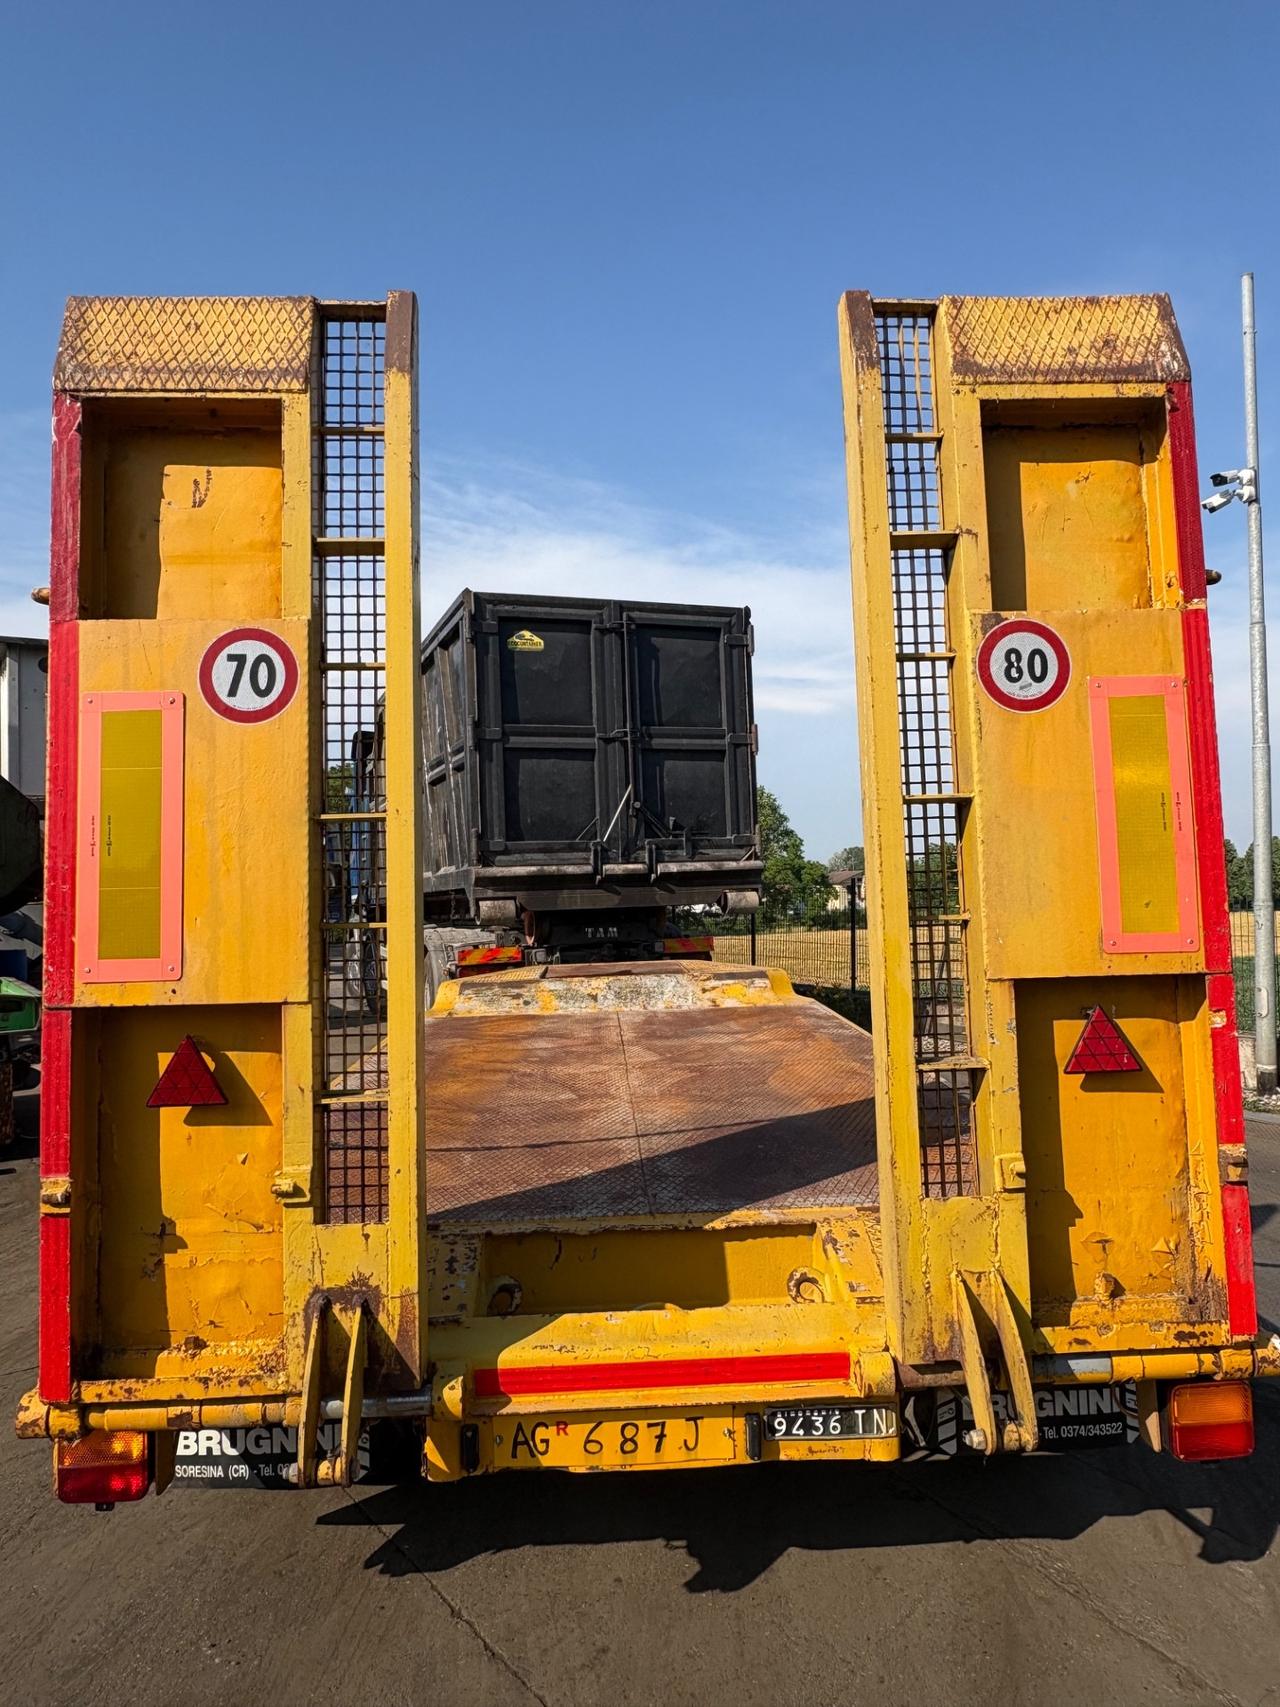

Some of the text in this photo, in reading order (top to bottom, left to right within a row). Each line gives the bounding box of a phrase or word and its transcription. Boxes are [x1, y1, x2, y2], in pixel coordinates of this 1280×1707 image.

[226, 653, 277, 698] 70
[1004, 647, 1048, 684] 80
[774, 1415, 841, 1436] 9436
[1043, 1422, 1123, 1439] Tel. 0374/343522
[176, 1424, 342, 1456] BRUGNNI
[175, 1465, 224, 1478] SORESINA
[228, 1464, 250, 1480] (CR)
[258, 1463, 275, 1477] Tel.
